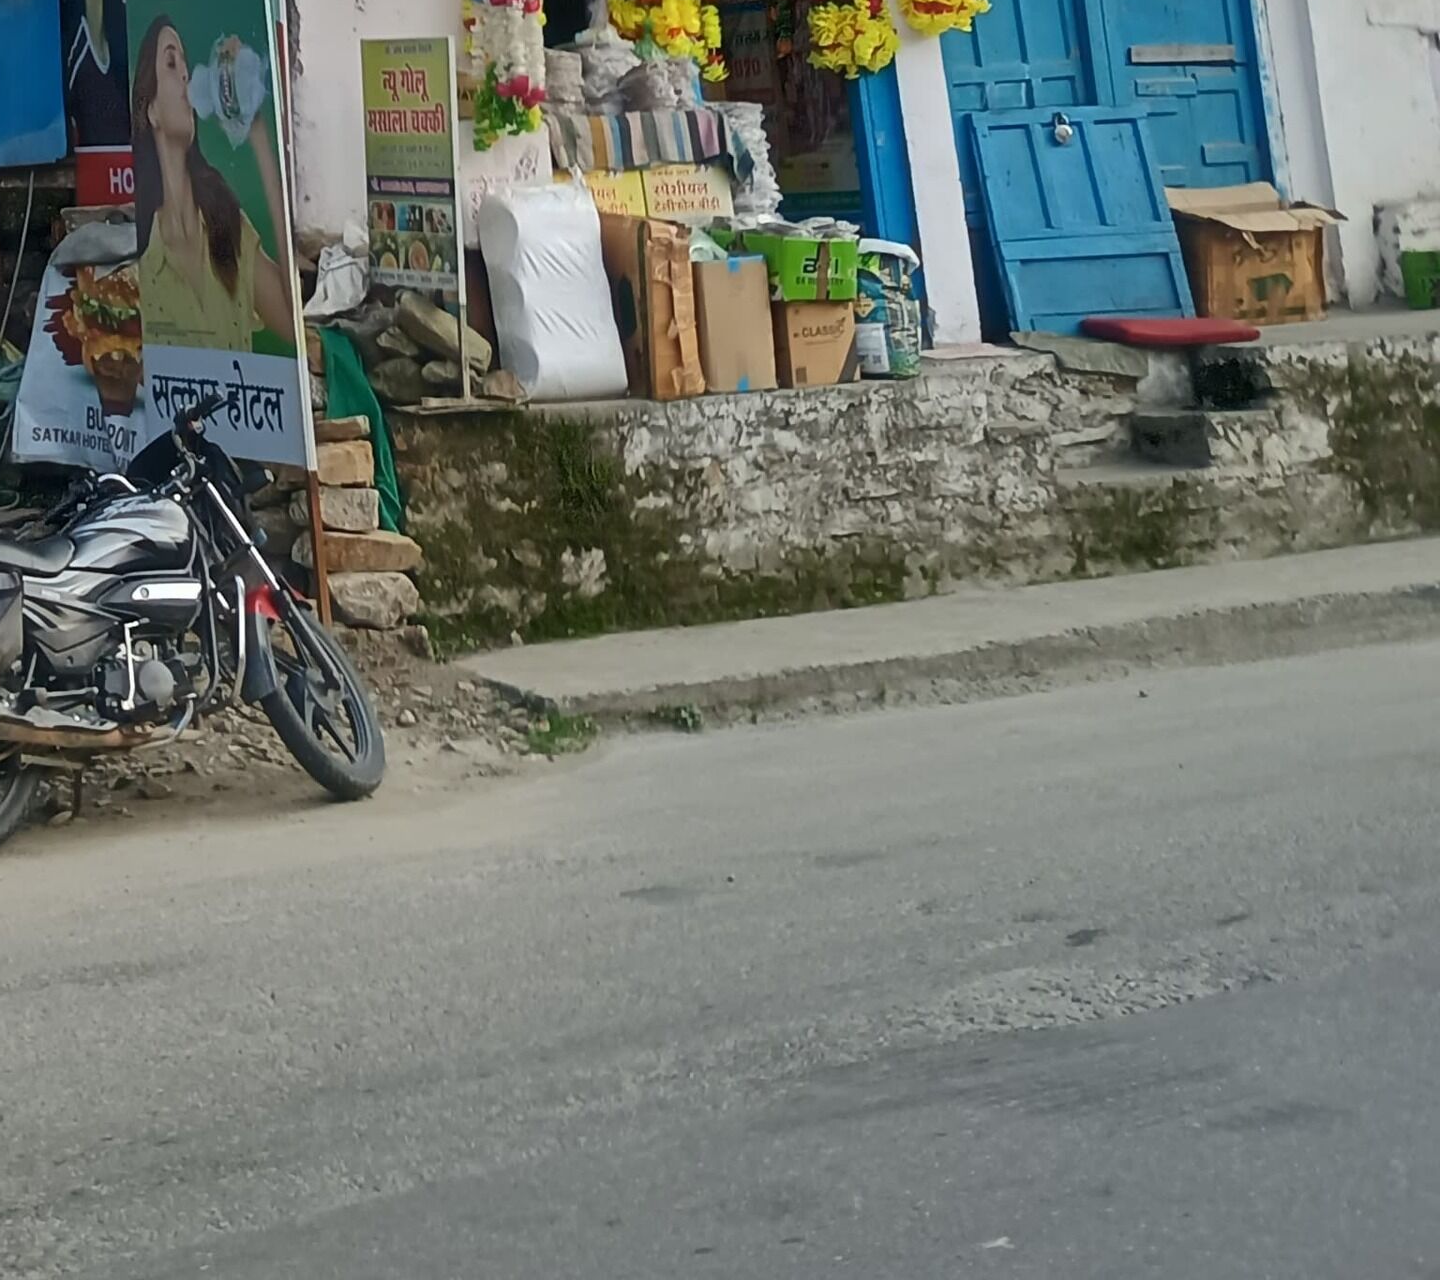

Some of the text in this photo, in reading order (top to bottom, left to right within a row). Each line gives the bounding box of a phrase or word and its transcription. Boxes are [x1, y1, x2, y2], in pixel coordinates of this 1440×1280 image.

[381, 62, 430, 103] न्यू गोलू
[367, 109, 408, 134] मसाला
[109, 167, 134, 194] HO
[224, 359, 285, 433] होटल
